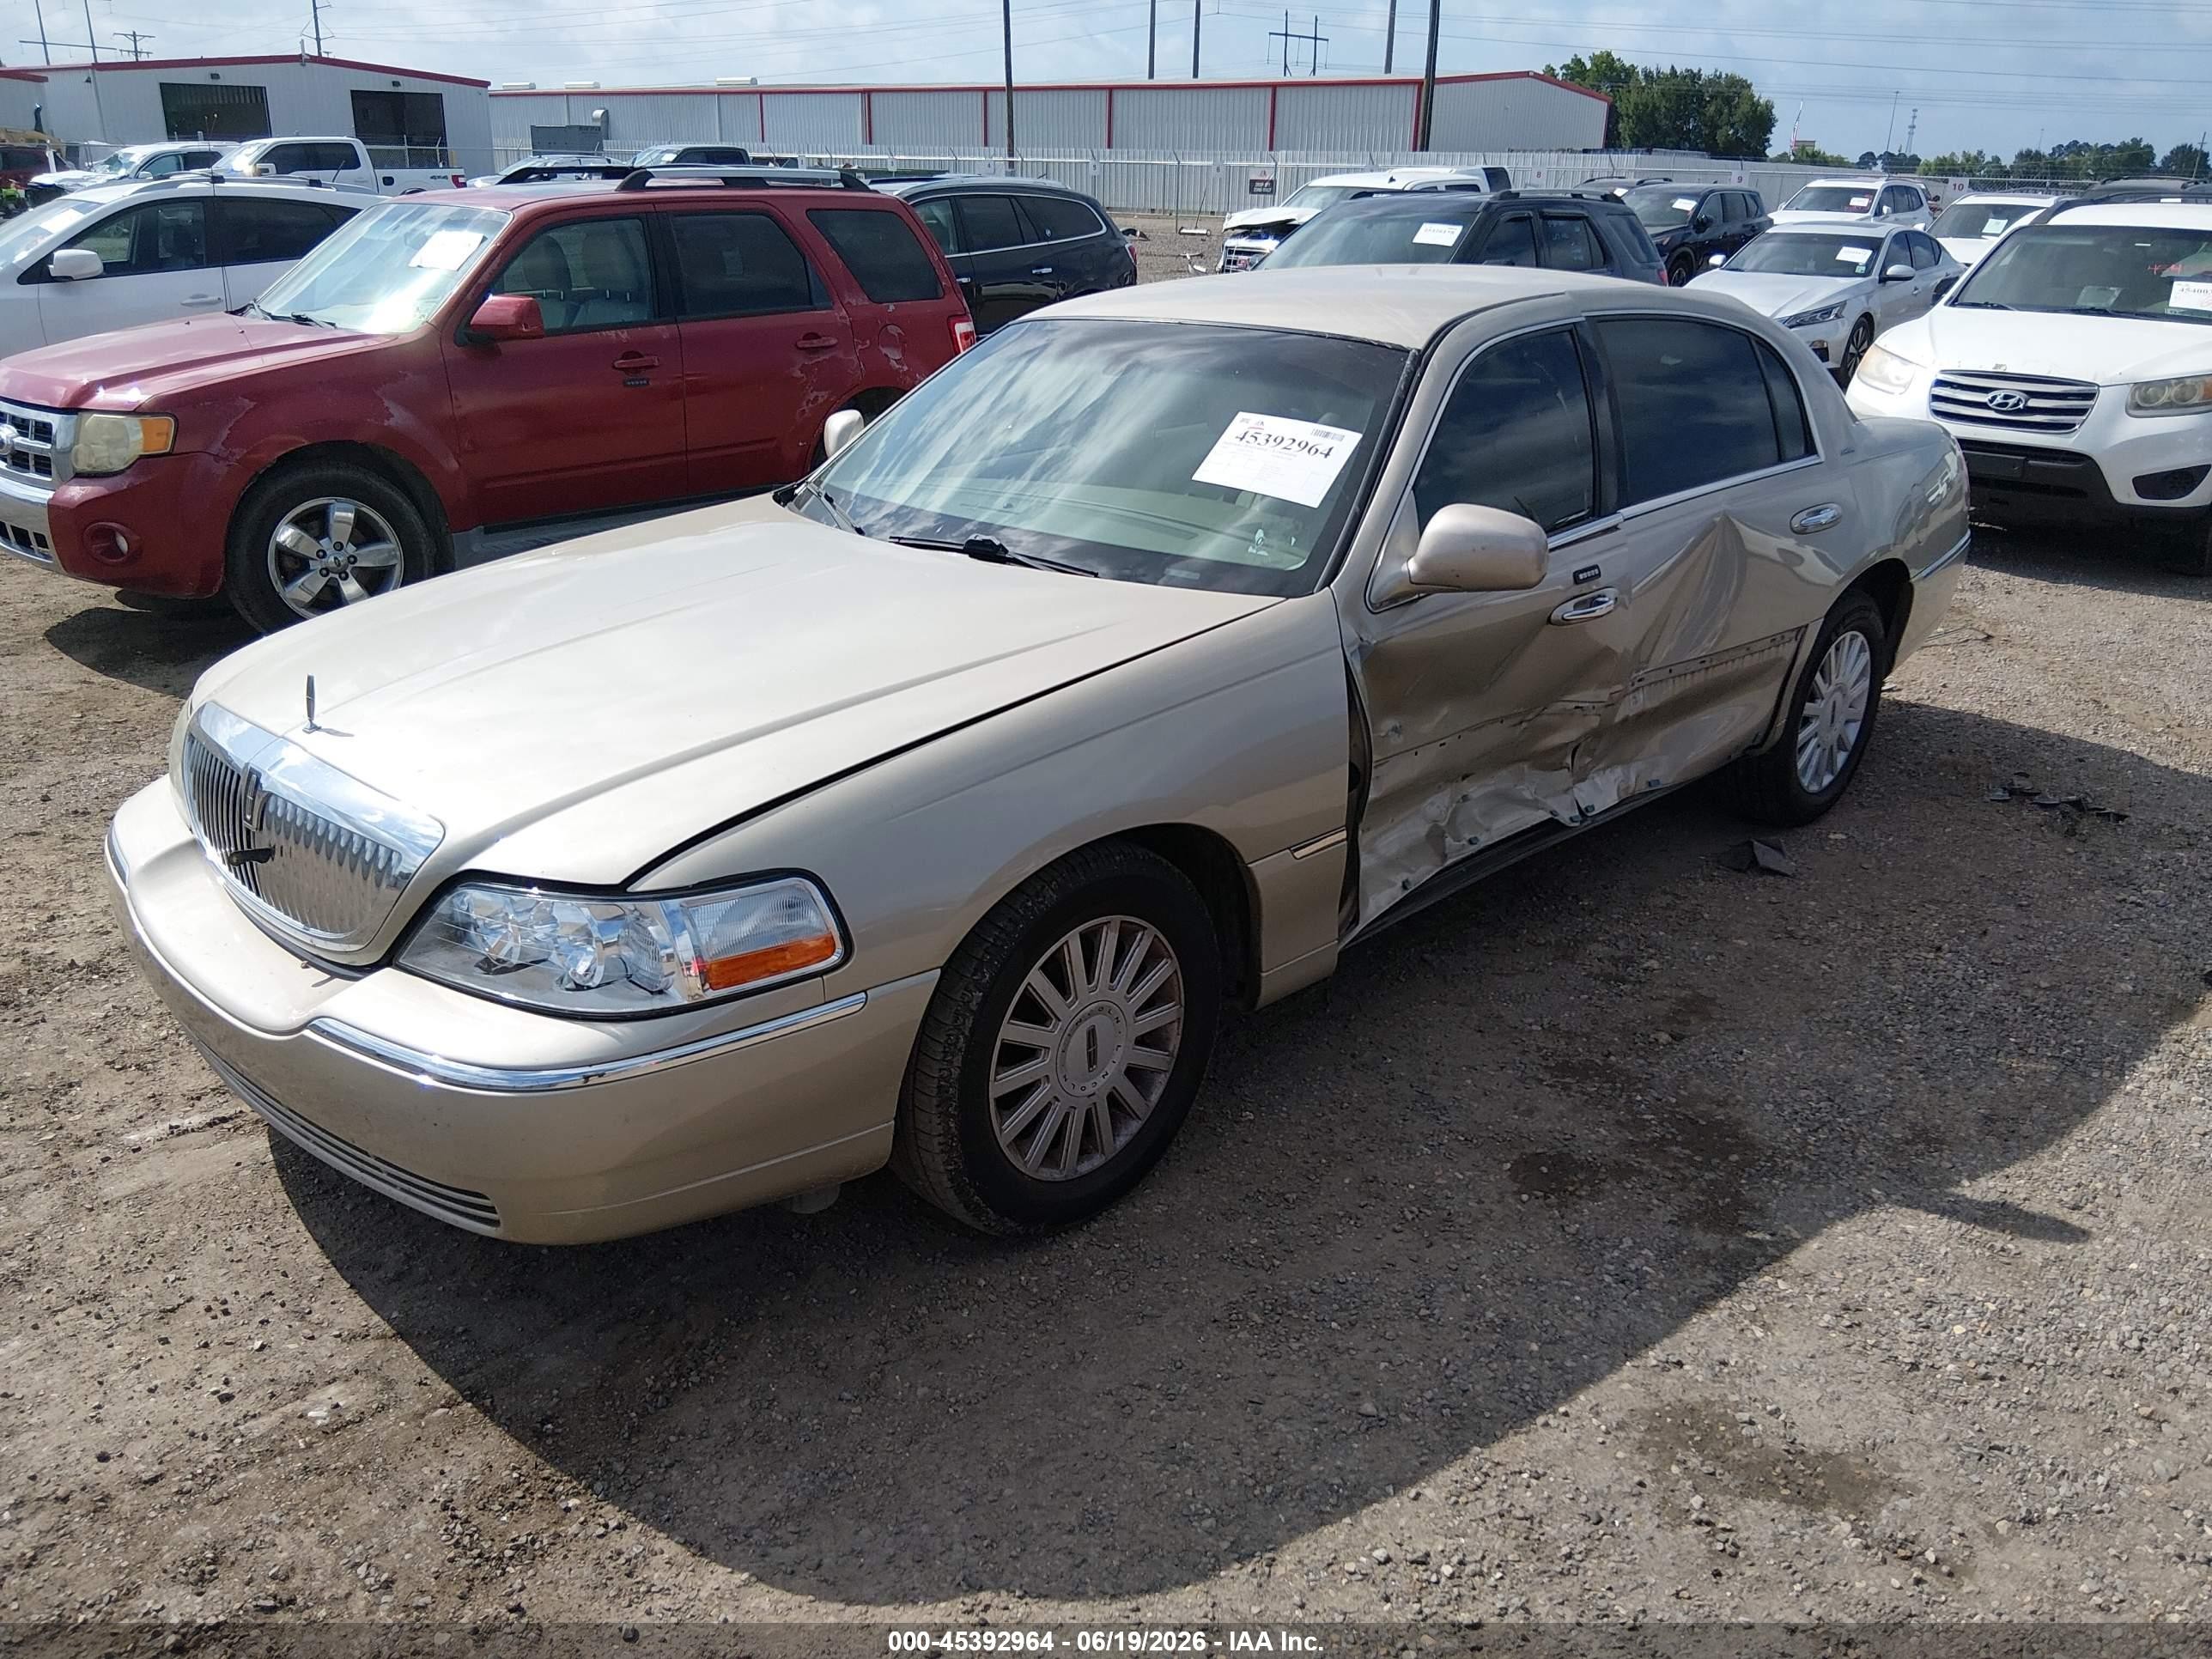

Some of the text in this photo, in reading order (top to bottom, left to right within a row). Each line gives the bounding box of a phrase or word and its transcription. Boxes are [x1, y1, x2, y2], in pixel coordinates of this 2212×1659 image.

[1737, 175, 1743, 184] 9
[1952, 182, 1965, 191] 10
[1235, 430, 1334, 459] 45392964
